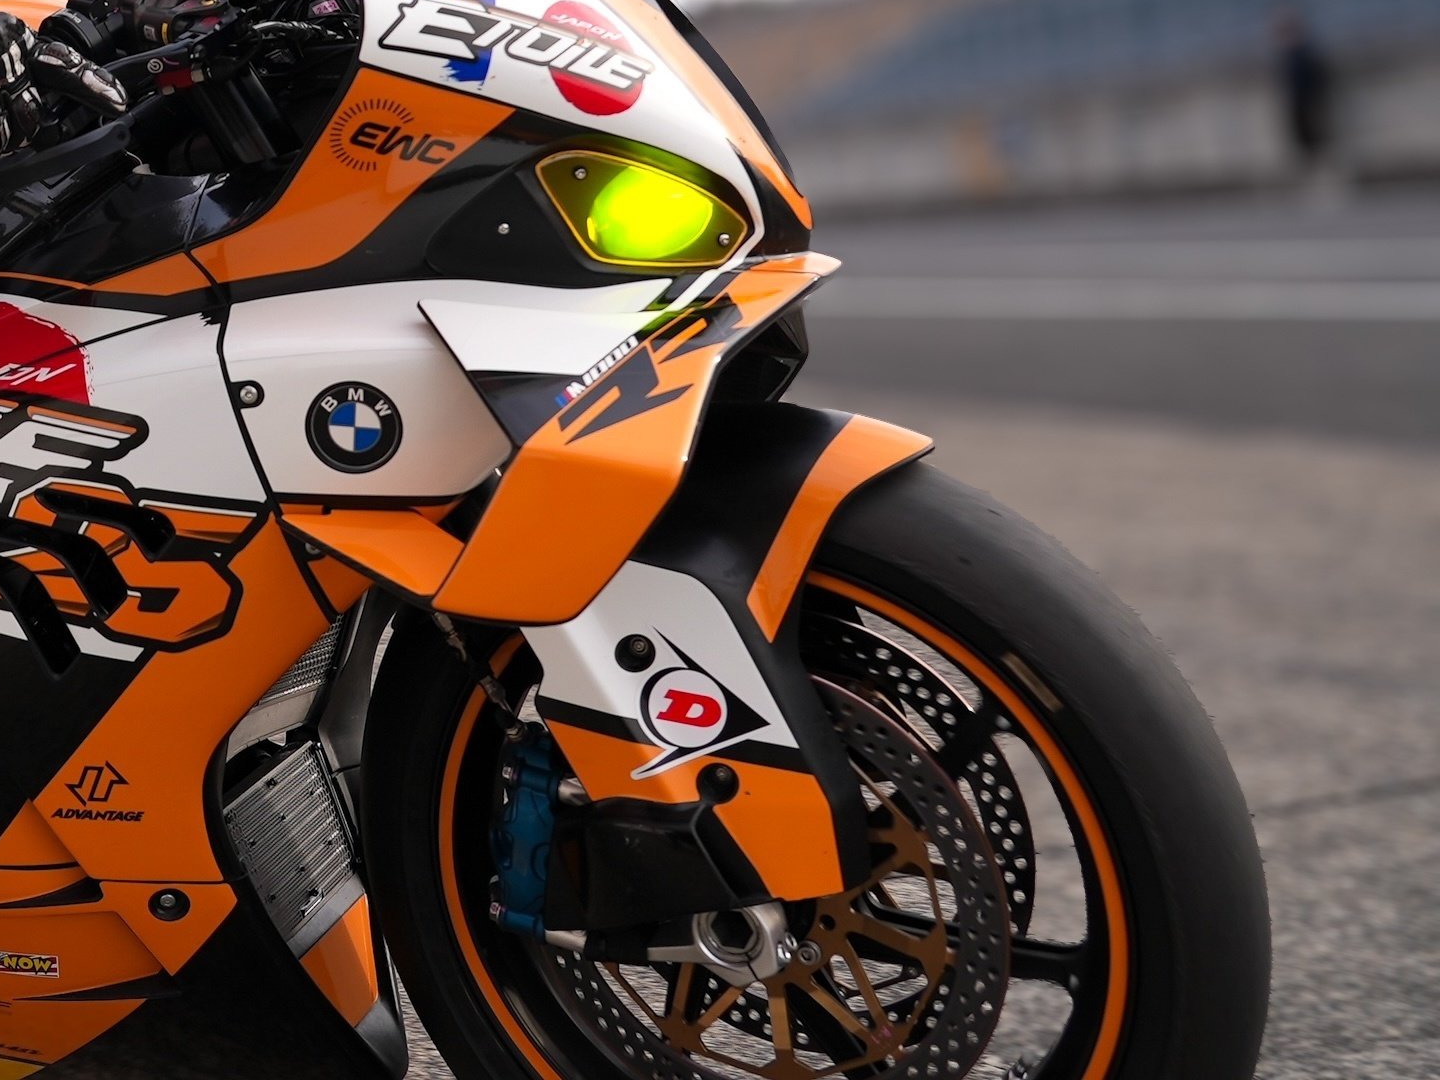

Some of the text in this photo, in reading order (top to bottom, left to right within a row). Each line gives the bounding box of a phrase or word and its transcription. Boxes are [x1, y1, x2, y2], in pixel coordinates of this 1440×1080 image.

[551, 14, 623, 41] JAPON
[350, 122, 456, 164] EWC
[565, 334, 640, 398] M1000
[321, 388, 392, 417] BMW
[657, 689, 722, 728] D
[50, 808, 145, 821] ADVANTAGE
[3, 956, 52, 972] NOW
